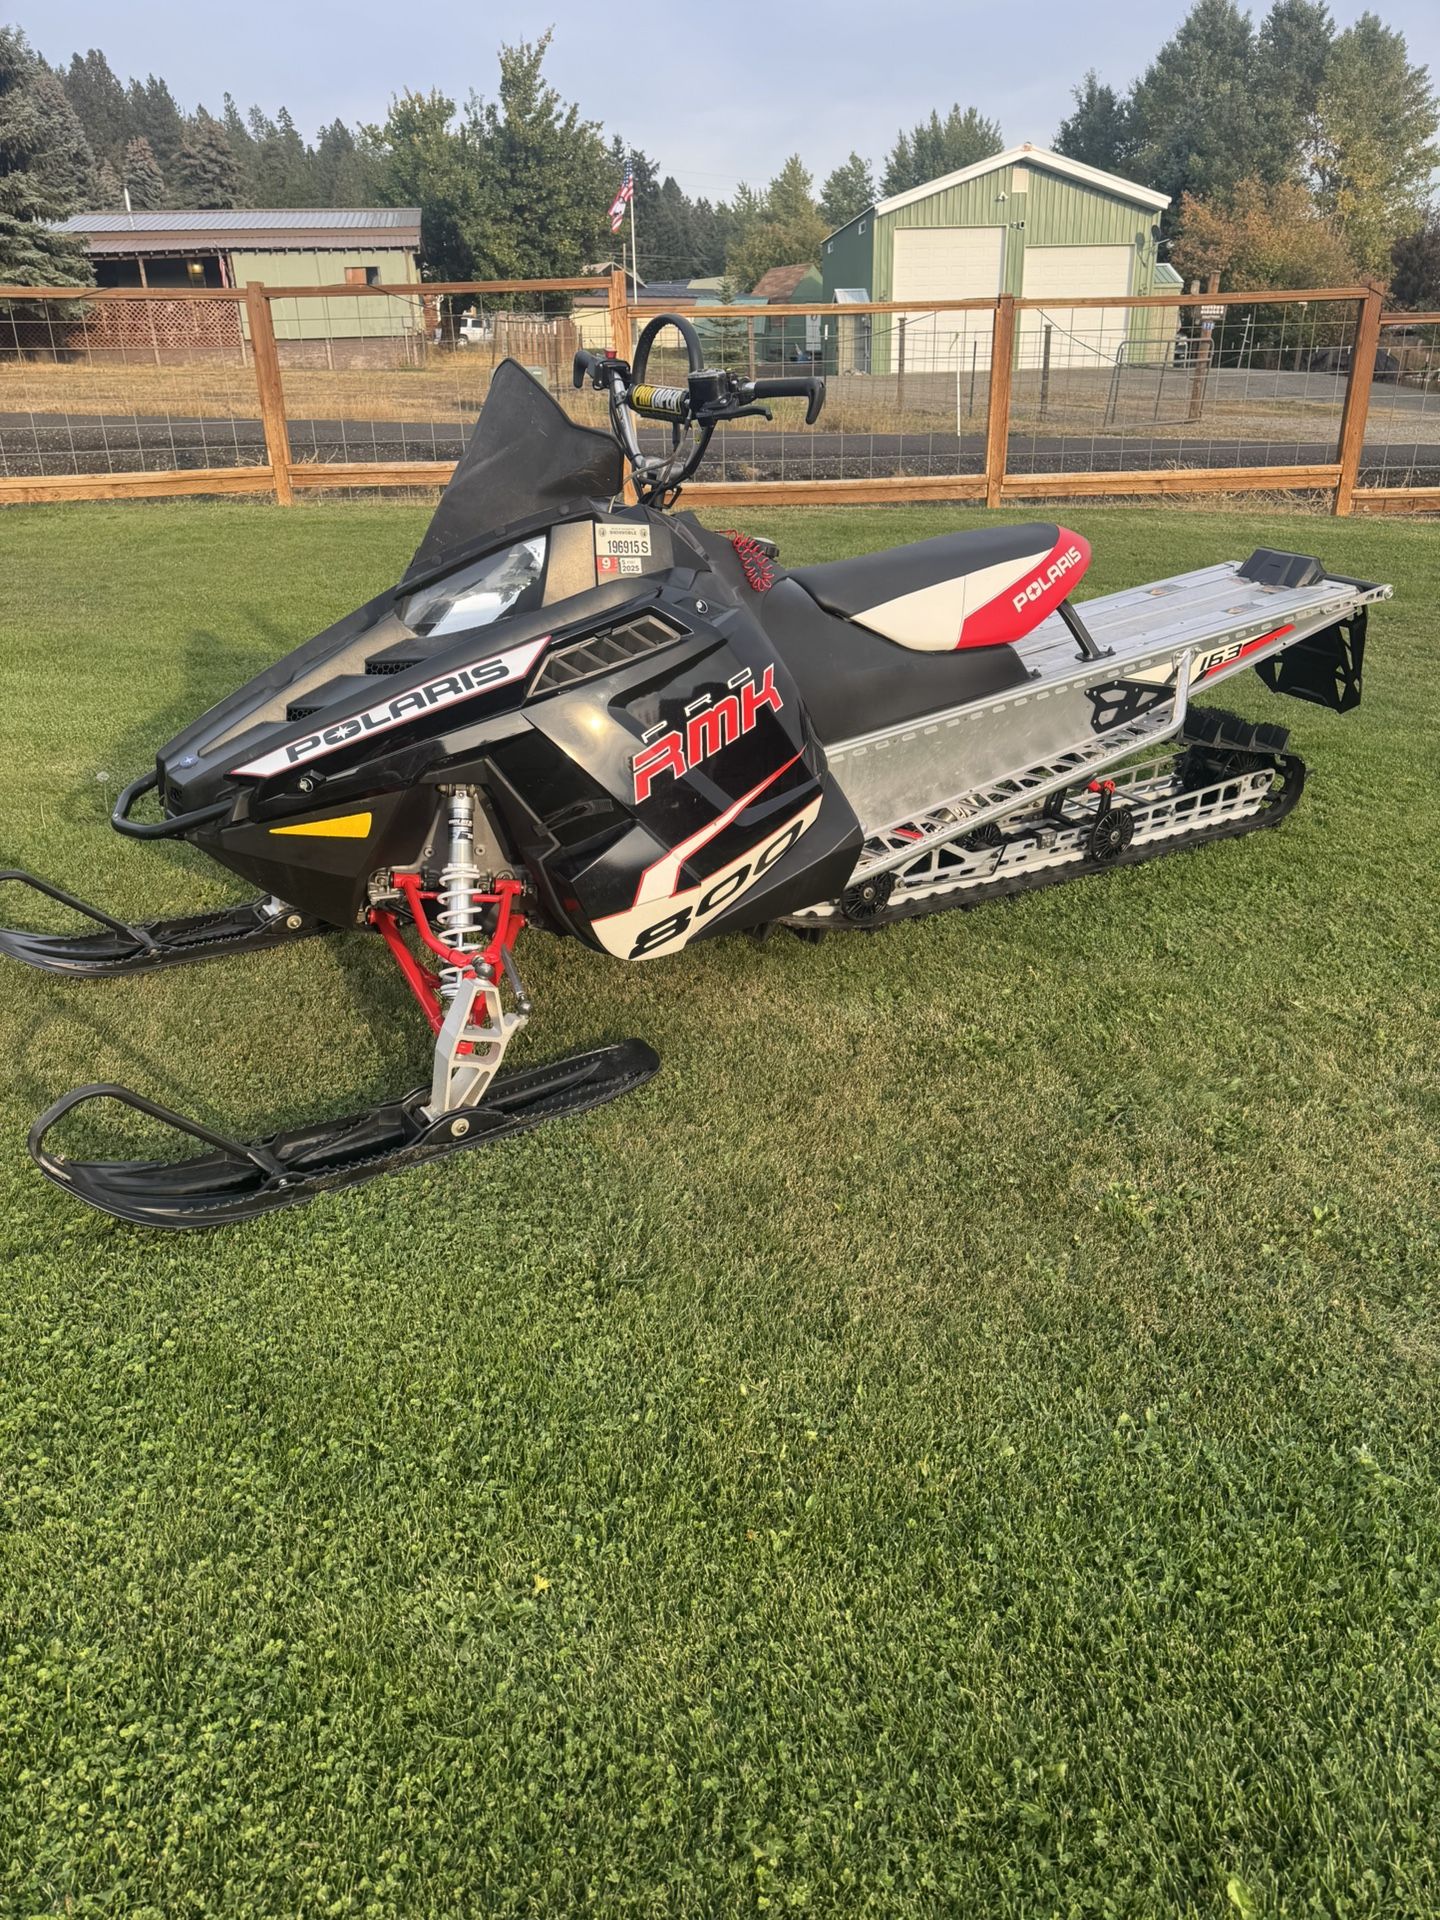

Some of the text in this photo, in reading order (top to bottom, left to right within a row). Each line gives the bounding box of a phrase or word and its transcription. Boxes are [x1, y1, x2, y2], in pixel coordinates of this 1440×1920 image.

[602, 557, 611, 569] 9
[608, 540, 649, 554] 196915 S
[1012, 546, 1082, 613] POLARIS
[1200, 643, 1242, 671] 163
[285, 659, 510, 763] POLARIS
[632, 663, 784, 805] RMK
[641, 667, 752, 743] PRO
[628, 819, 804, 960] 800
